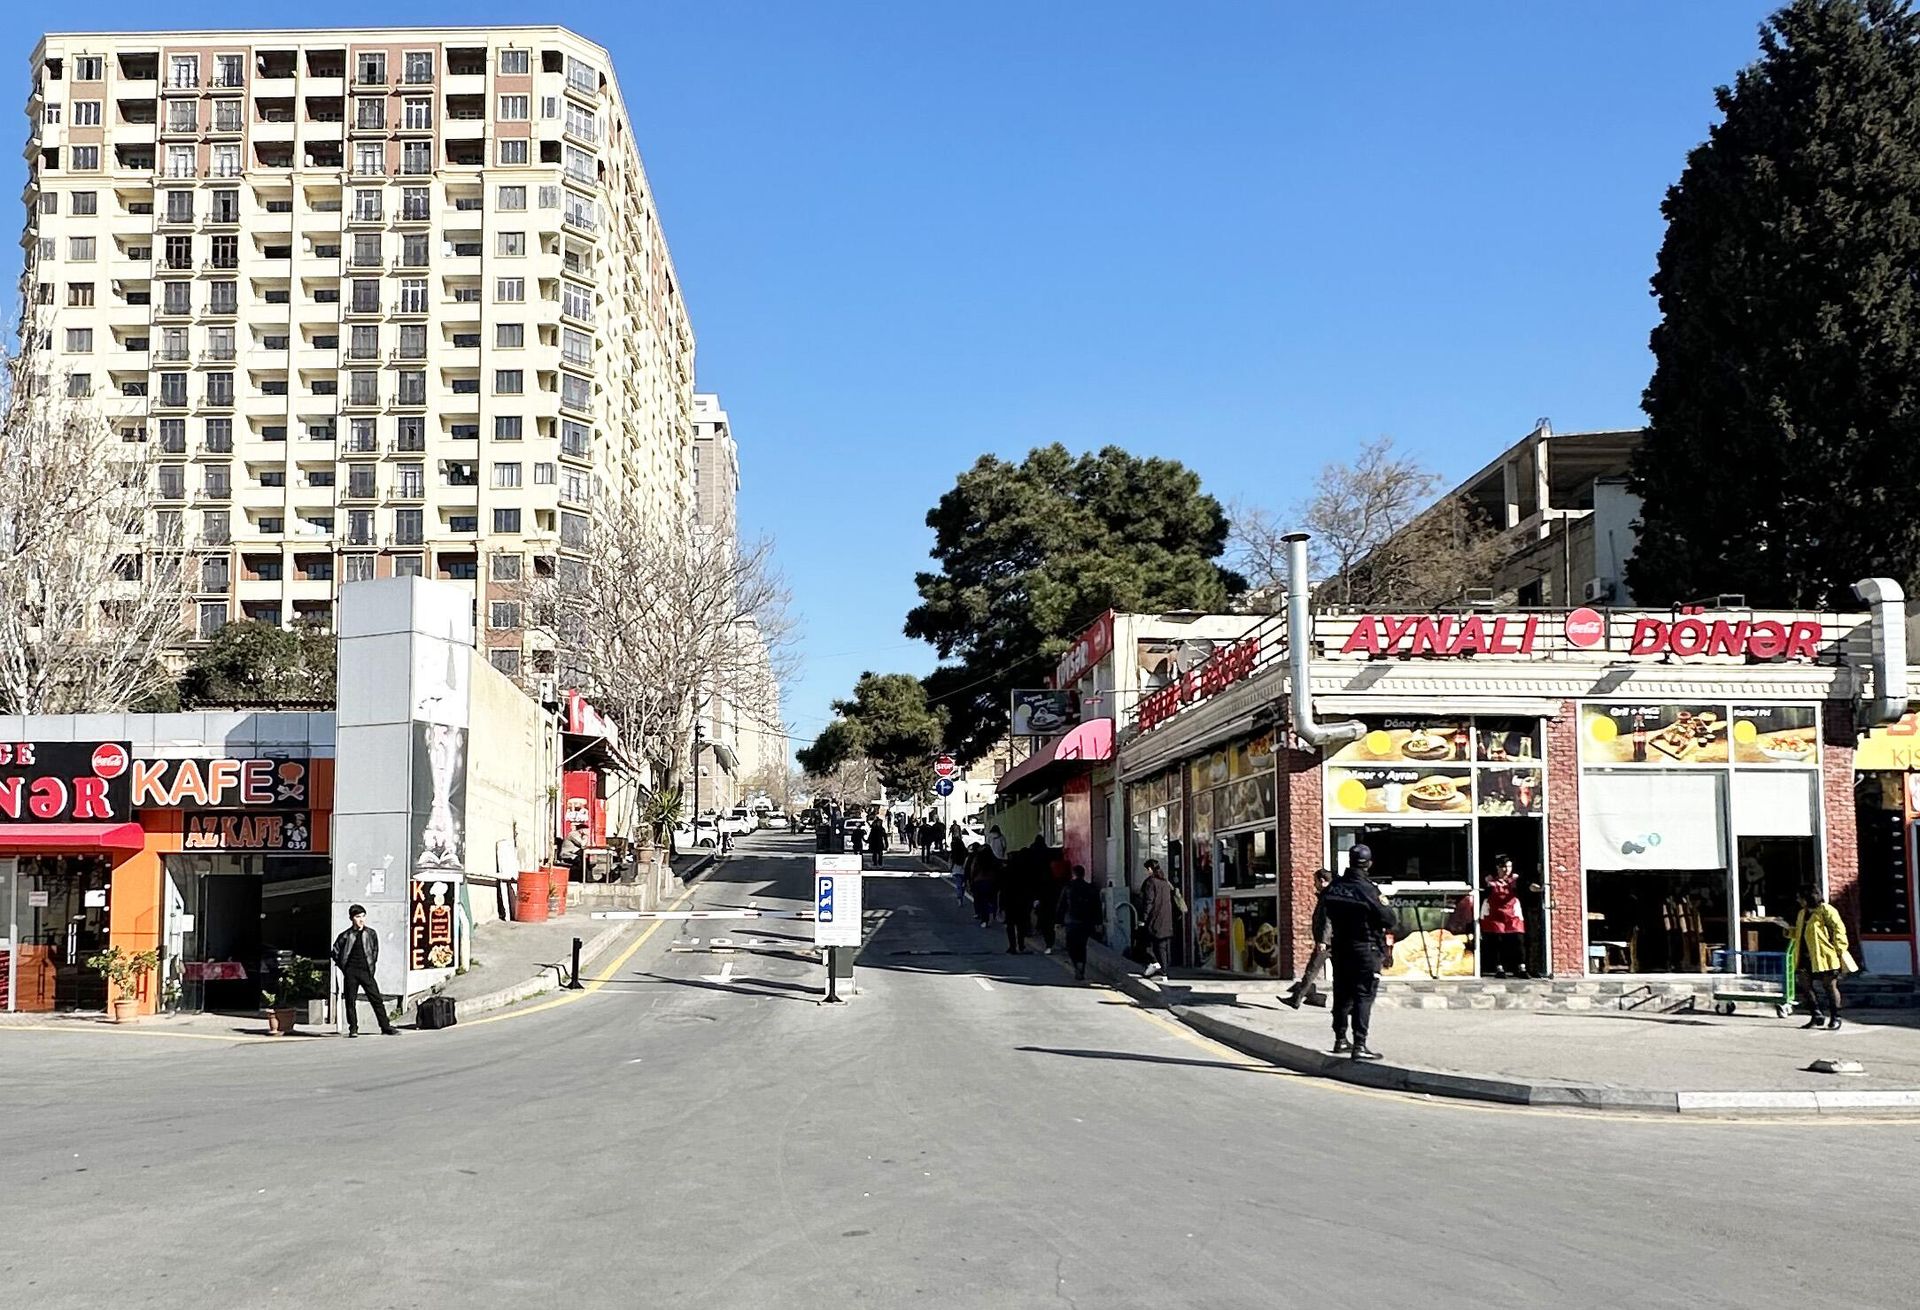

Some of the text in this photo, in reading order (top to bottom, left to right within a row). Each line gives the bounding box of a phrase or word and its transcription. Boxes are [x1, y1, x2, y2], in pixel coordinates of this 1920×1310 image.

[1340, 615, 1538, 655] AYNALI
[1630, 606, 1822, 658] DÖNƏR
[132, 759, 275, 806] KAFE
[184, 816, 283, 848] AZ KAFE
[413, 880, 426, 970] KAFE
